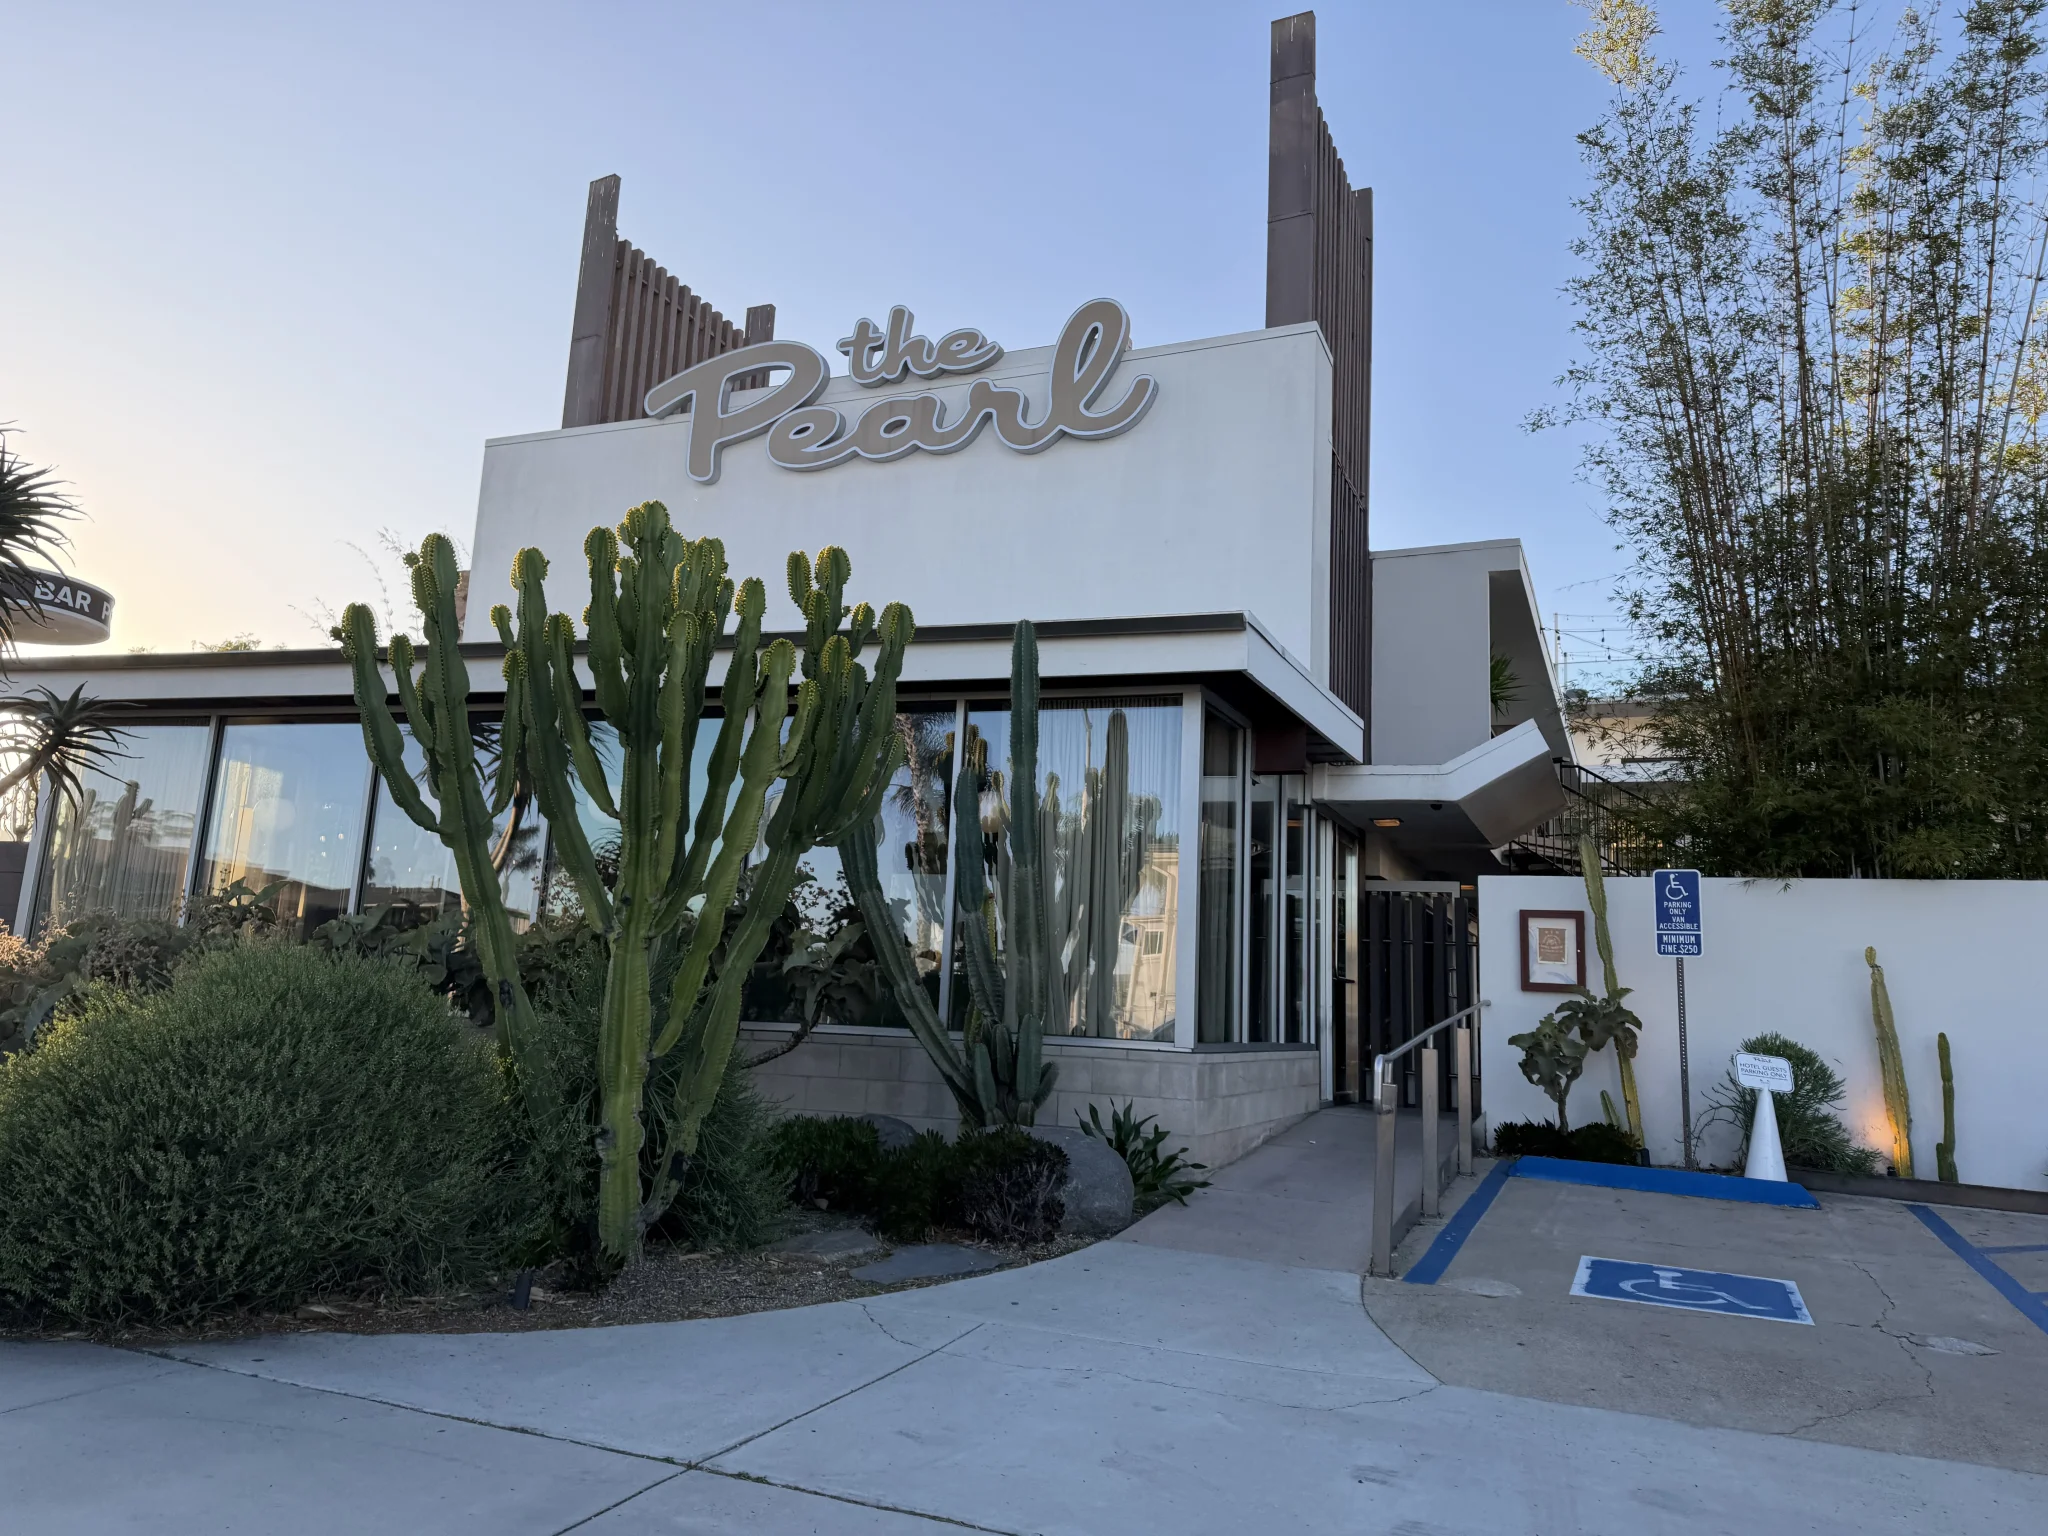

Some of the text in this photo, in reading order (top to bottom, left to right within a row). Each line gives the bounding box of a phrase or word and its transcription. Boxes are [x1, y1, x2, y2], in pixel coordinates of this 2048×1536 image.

[837, 305, 1004, 388] the
[644, 298, 1159, 485] Pearl
[33, 579, 92, 613] BAR
[1662, 934, 1696, 944] MINIMUM
[1661, 944, 1698, 954] FINE $250
[1740, 1067, 1769, 1076] PARKING
[1762, 1065, 1788, 1074] GUESTS
